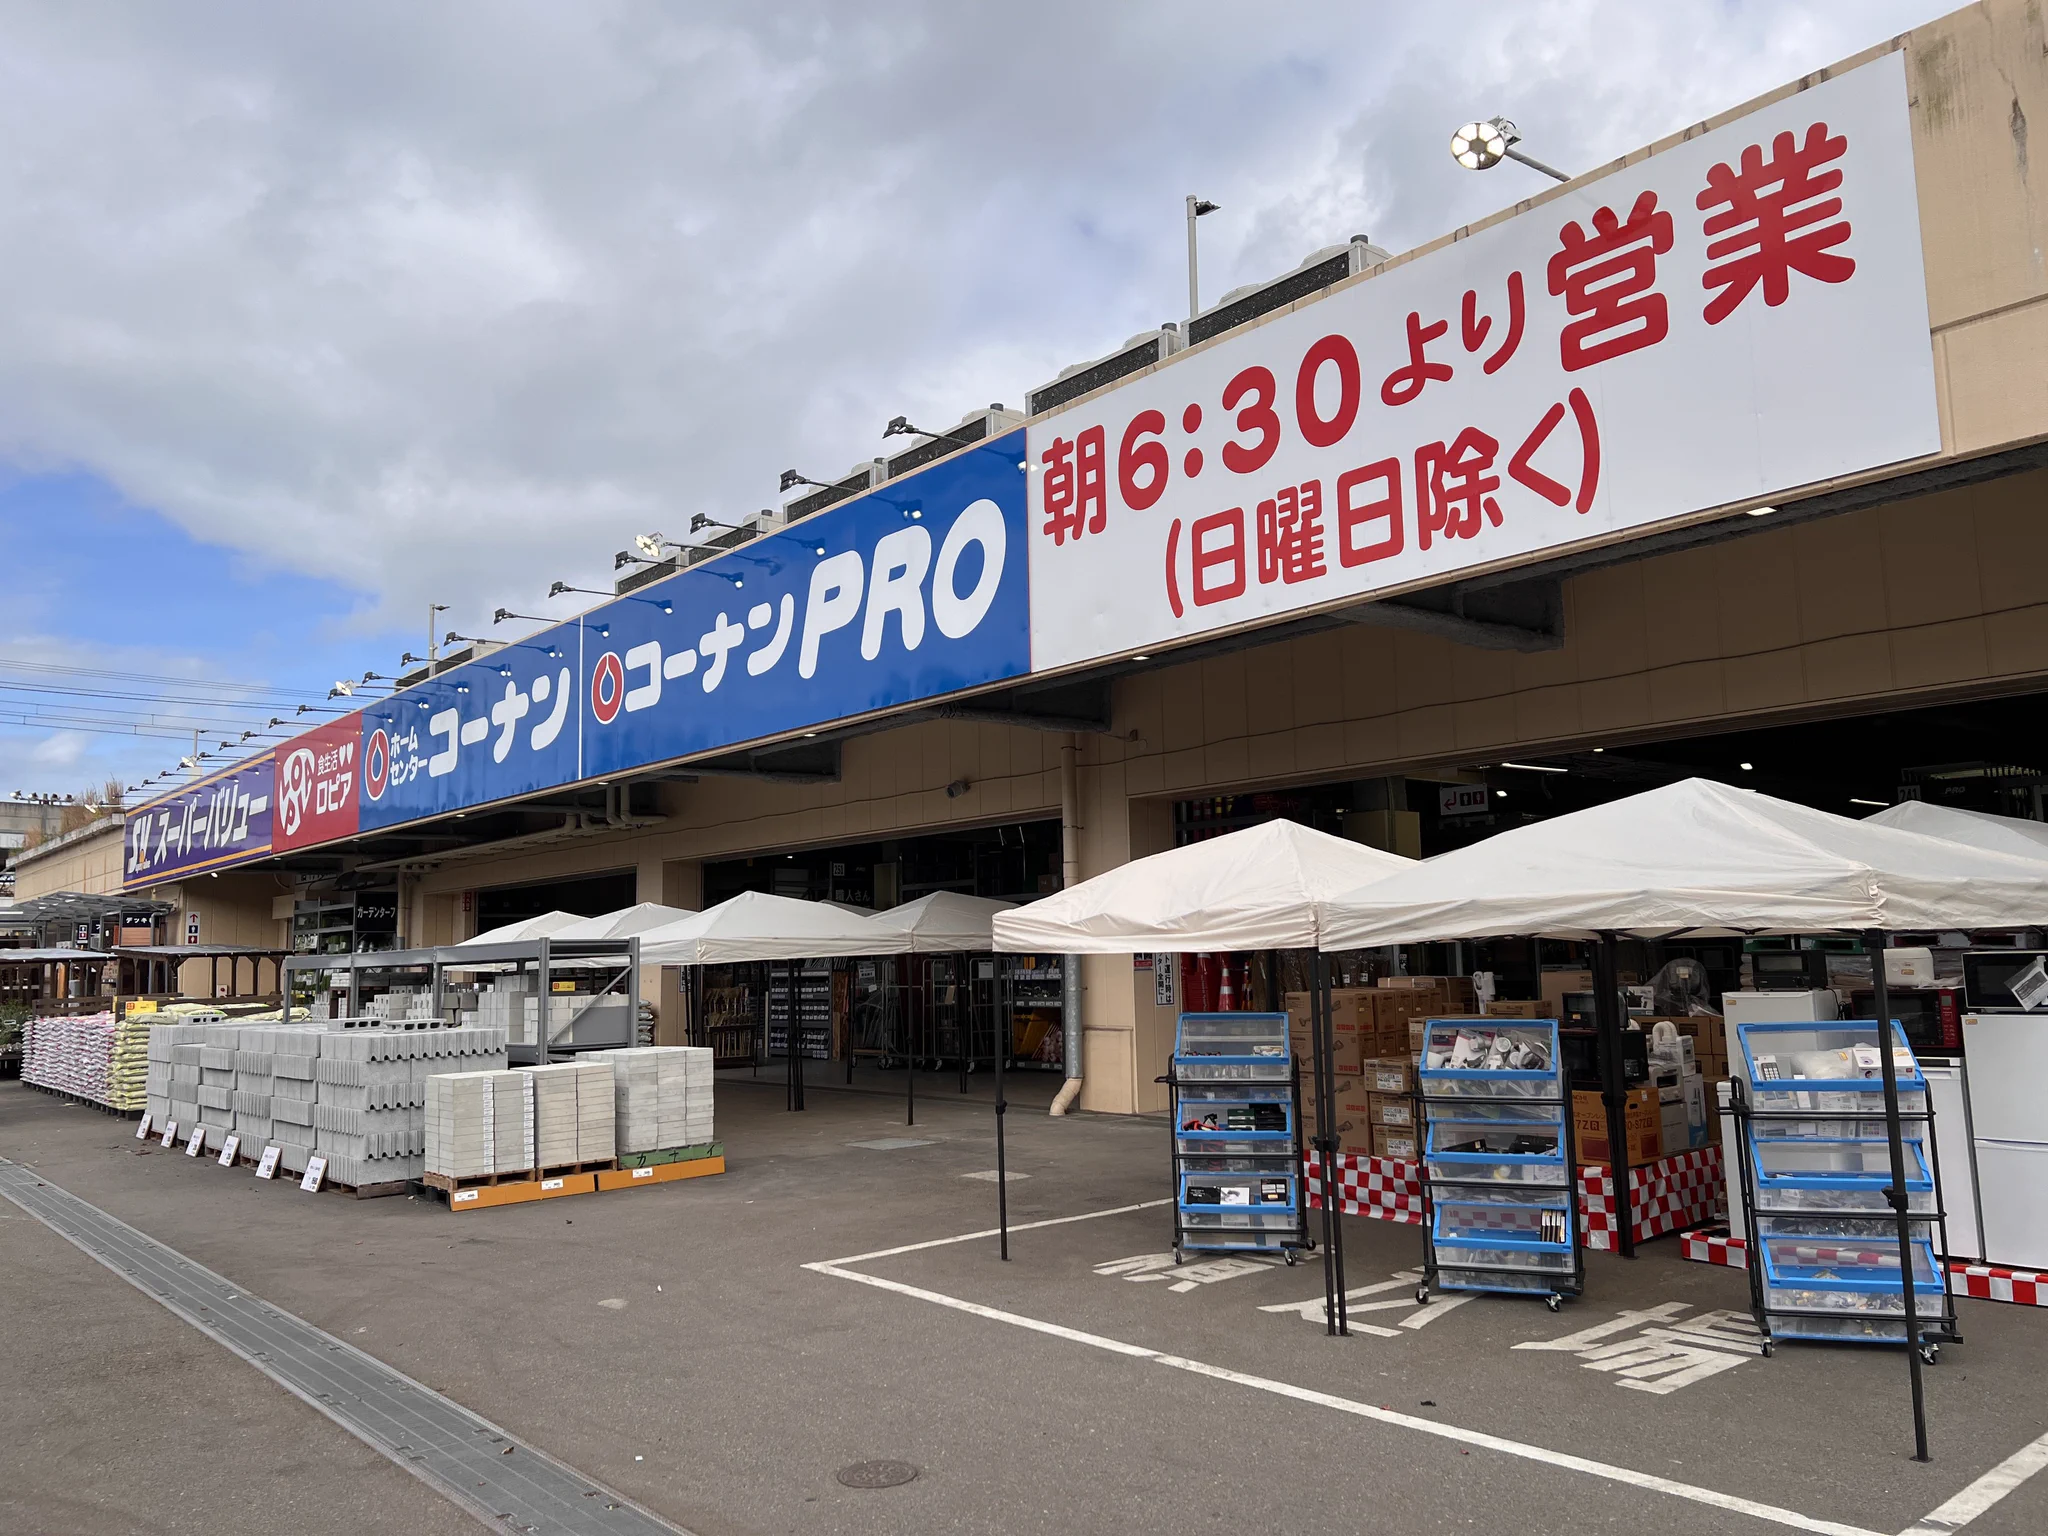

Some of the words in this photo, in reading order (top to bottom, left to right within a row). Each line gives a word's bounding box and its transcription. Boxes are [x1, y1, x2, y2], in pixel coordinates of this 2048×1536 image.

[1041, 121, 1857, 546] 朝6:30より営業
[1165, 387, 1600, 618] (日曜日除く)
[390, 726, 418, 758] ホーム
[428, 667, 571, 778] コーナン
[316, 771, 352, 815] ロピア
[390, 754, 428, 786] センター
[154, 784, 267, 866] スーパーバリュー
[357, 906, 396, 918] ガーデンターフ
